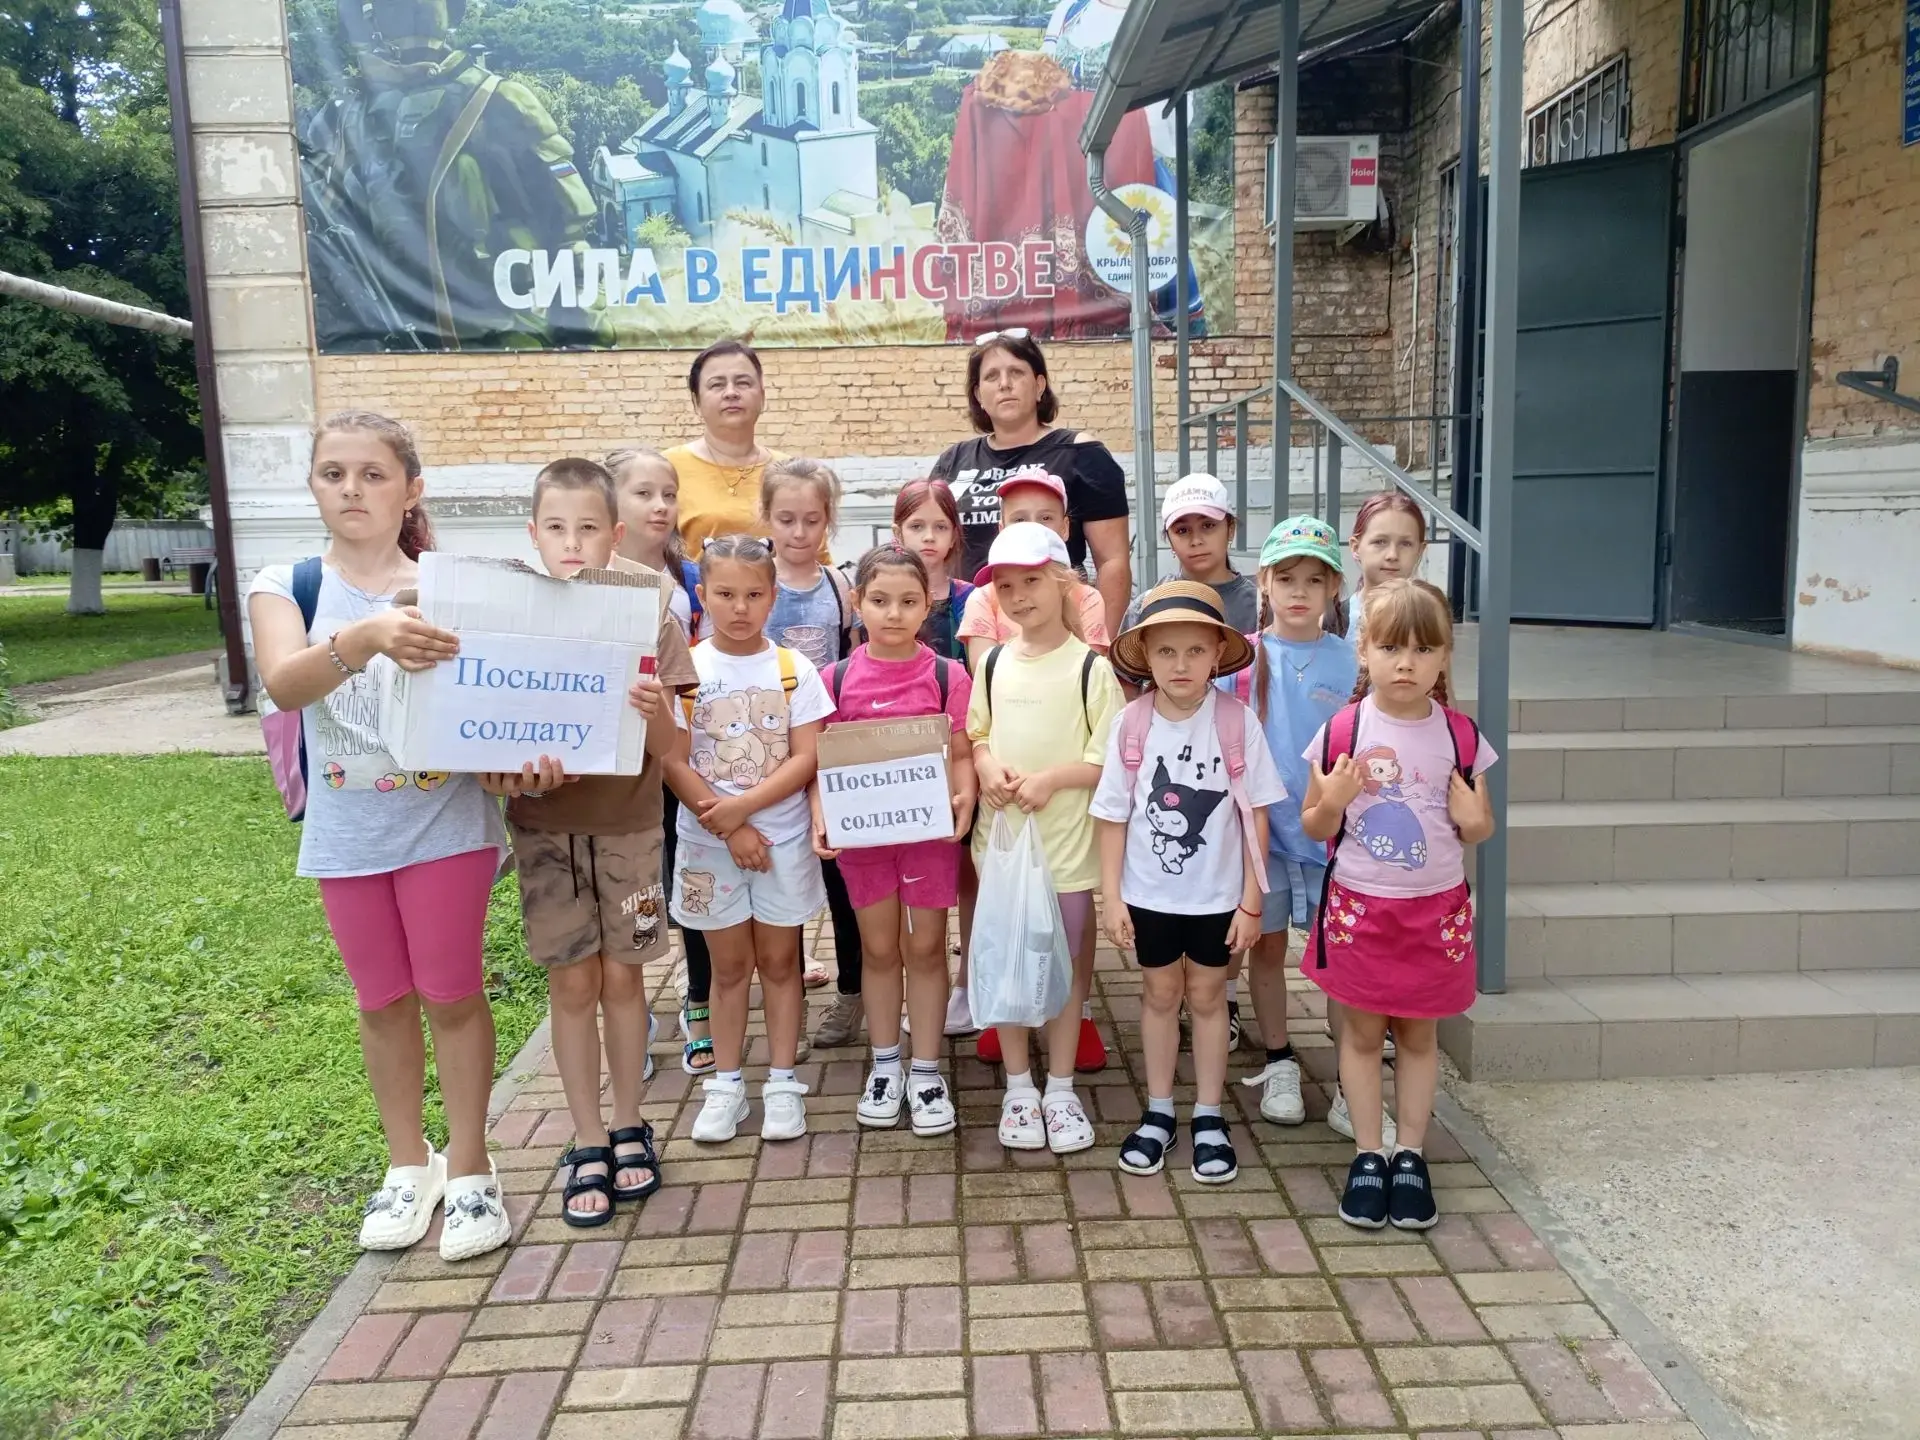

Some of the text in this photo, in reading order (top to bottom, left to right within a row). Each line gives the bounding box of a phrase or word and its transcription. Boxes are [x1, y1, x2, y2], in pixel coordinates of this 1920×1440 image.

[1351, 168, 1375, 177] Haier
[1096, 256, 1132, 268] КРЫЛЬ
[493, 241, 1056, 315] СИЛА В ЕДИНСТВЕ
[1107, 271, 1169, 282] ЕДИН ХОМ
[979, 463, 1045, 480] BREAK
[971, 495, 999, 507] YO
[958, 510, 1001, 526] LIM
[455, 656, 607, 694] Посылка
[459, 719, 593, 751] солдату
[823, 765, 938, 794] Посылка
[840, 805, 934, 832] солдату
[1352, 1175, 1383, 1189] PUMA
[1392, 1173, 1423, 1189] PUMA
